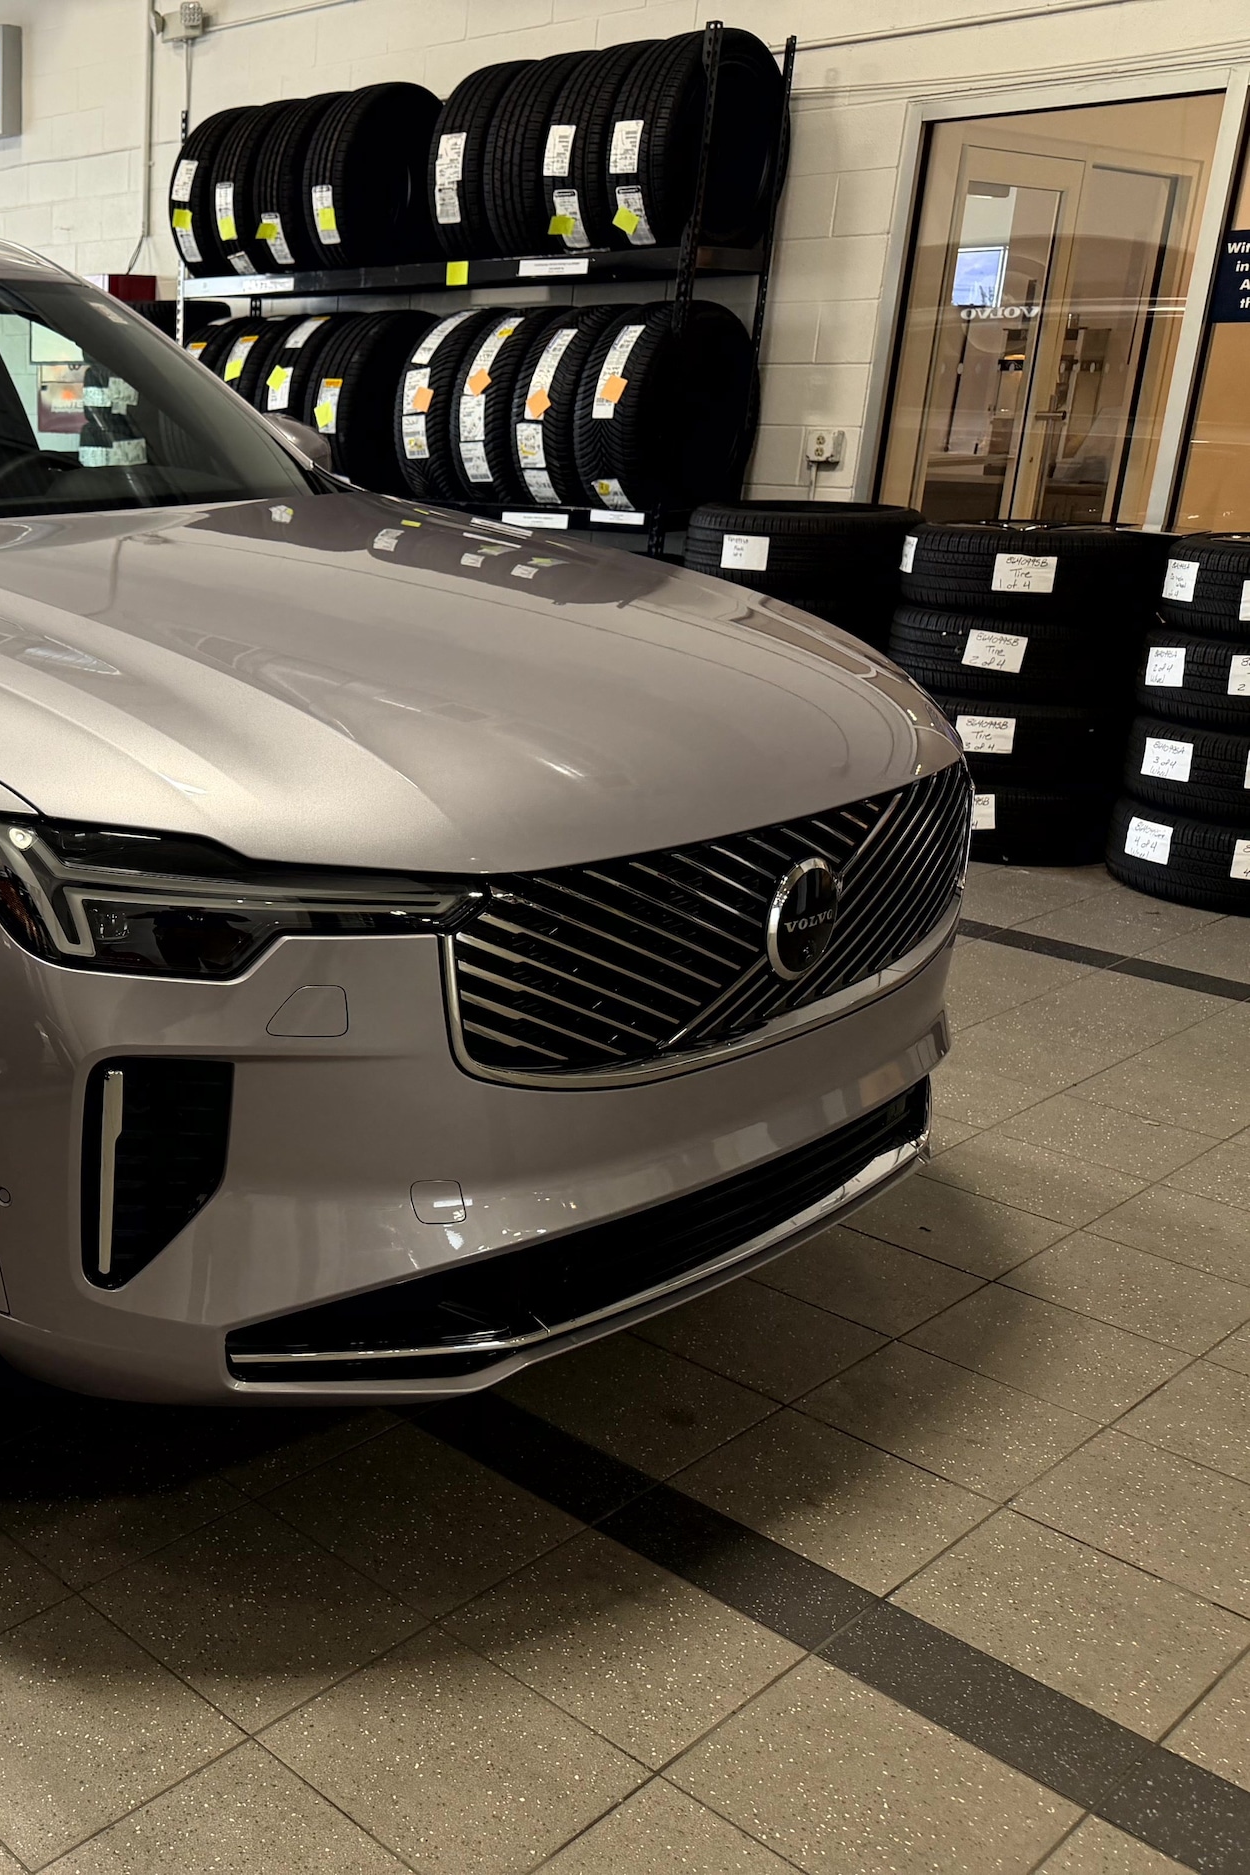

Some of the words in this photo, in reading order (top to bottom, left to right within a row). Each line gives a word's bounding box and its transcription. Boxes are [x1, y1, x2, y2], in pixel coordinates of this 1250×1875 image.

[1235, 260, 1250, 272] in
[1010, 568, 1032, 578] Tire
[1007, 579, 1017, 589] of
[1023, 581, 1030, 590] 4
[985, 645, 1005, 656] Tire
[969, 655, 979, 664] 2
[981, 657, 995, 666] of
[996, 659, 1006, 669] 4
[1153, 756, 1160, 764] 3
[1150, 841, 1158, 852] 4
[784, 908, 833, 933] VOLVO
